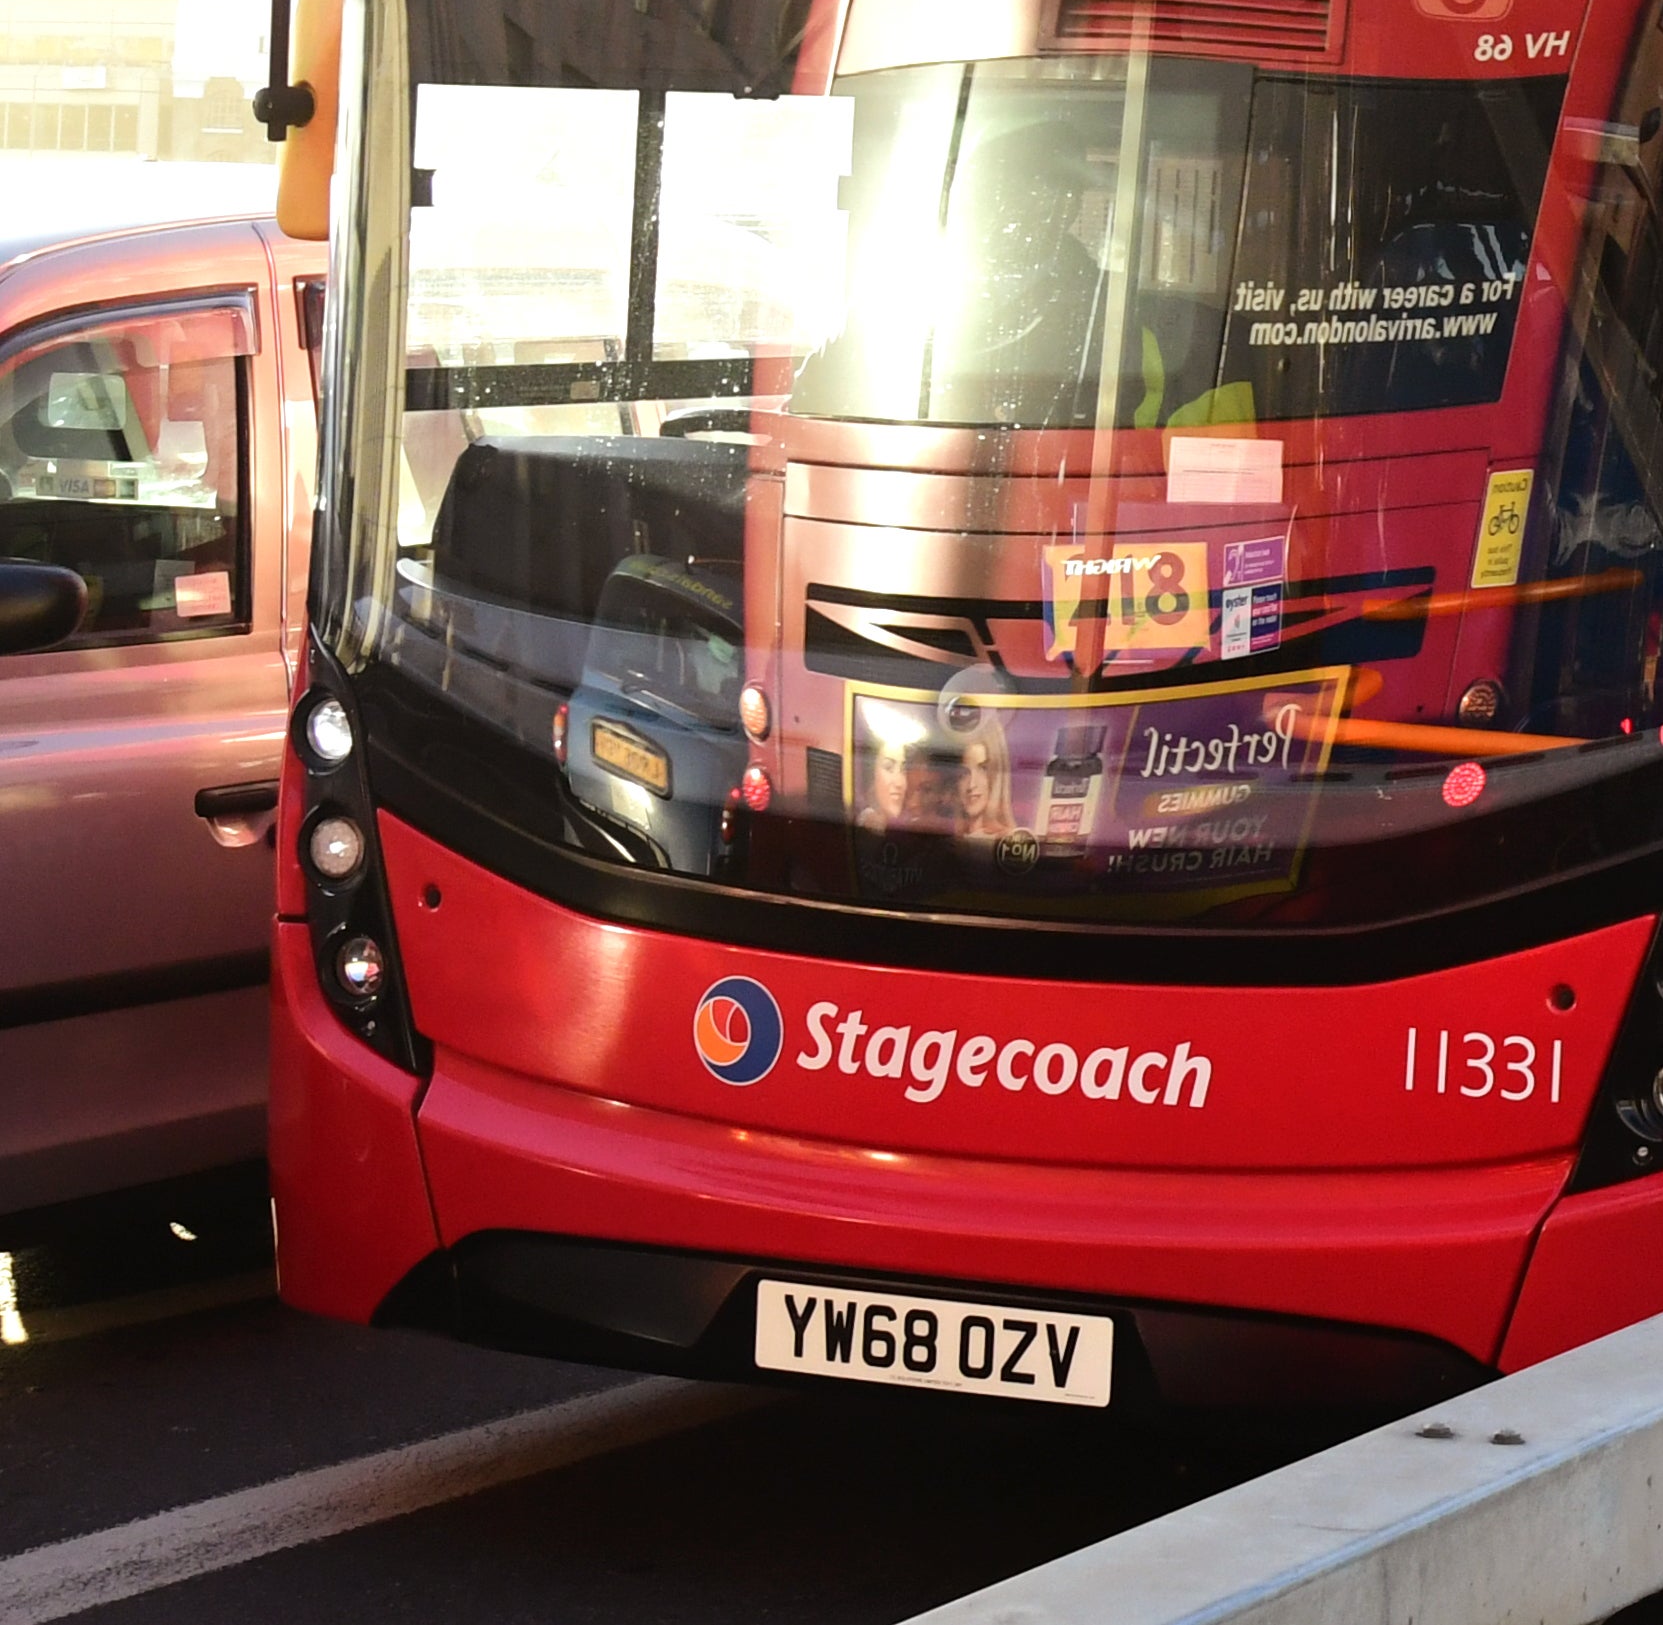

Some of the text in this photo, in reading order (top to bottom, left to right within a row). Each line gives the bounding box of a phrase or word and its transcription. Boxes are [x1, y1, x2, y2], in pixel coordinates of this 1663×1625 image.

[60, 478, 90, 494] VISA
[796, 1000, 1213, 1109] Stagecoach
[1403, 1026, 1563, 1104] 11331
[783, 1292, 1082, 1389] YW68 OZV
